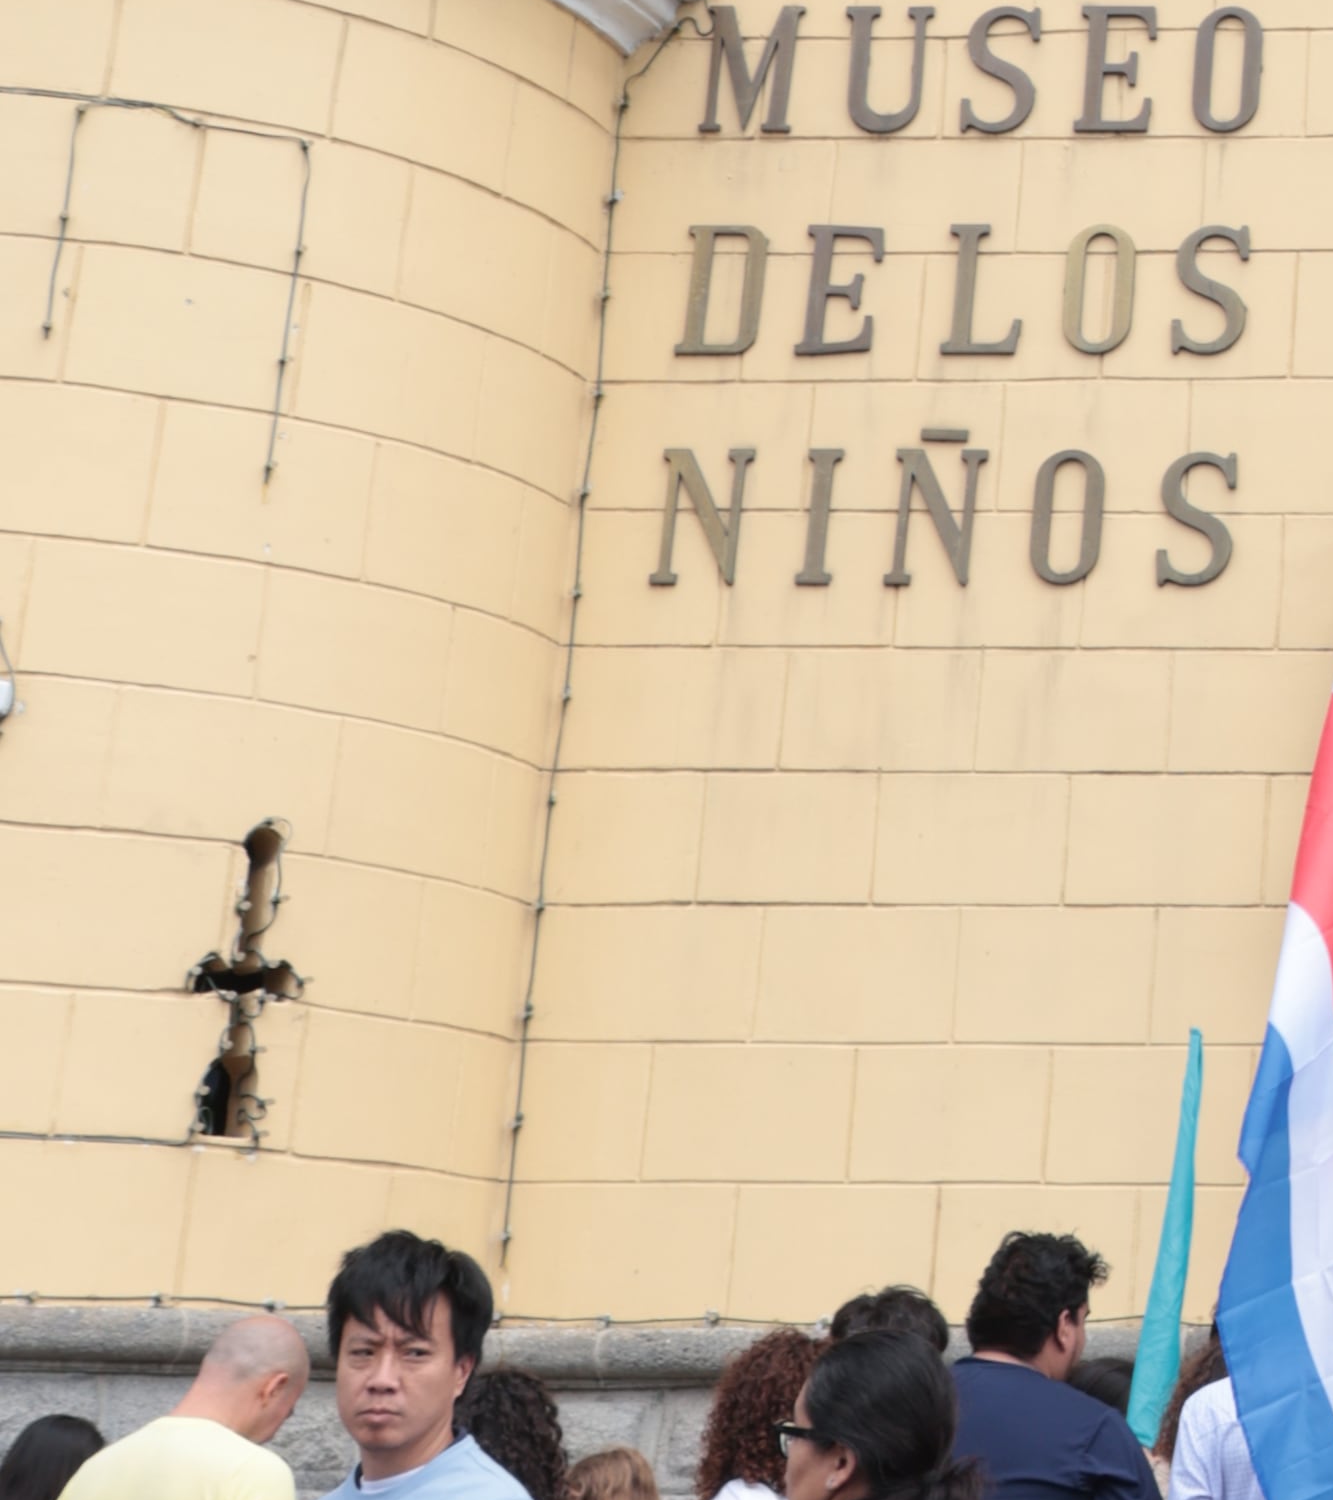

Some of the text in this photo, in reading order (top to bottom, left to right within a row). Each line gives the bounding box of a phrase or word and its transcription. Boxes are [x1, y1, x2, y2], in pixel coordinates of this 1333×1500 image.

[698, 5, 1264, 134] MUSEO
[673, 222, 1250, 357] DE LOS
[648, 427, 1239, 587] NIÑOS
